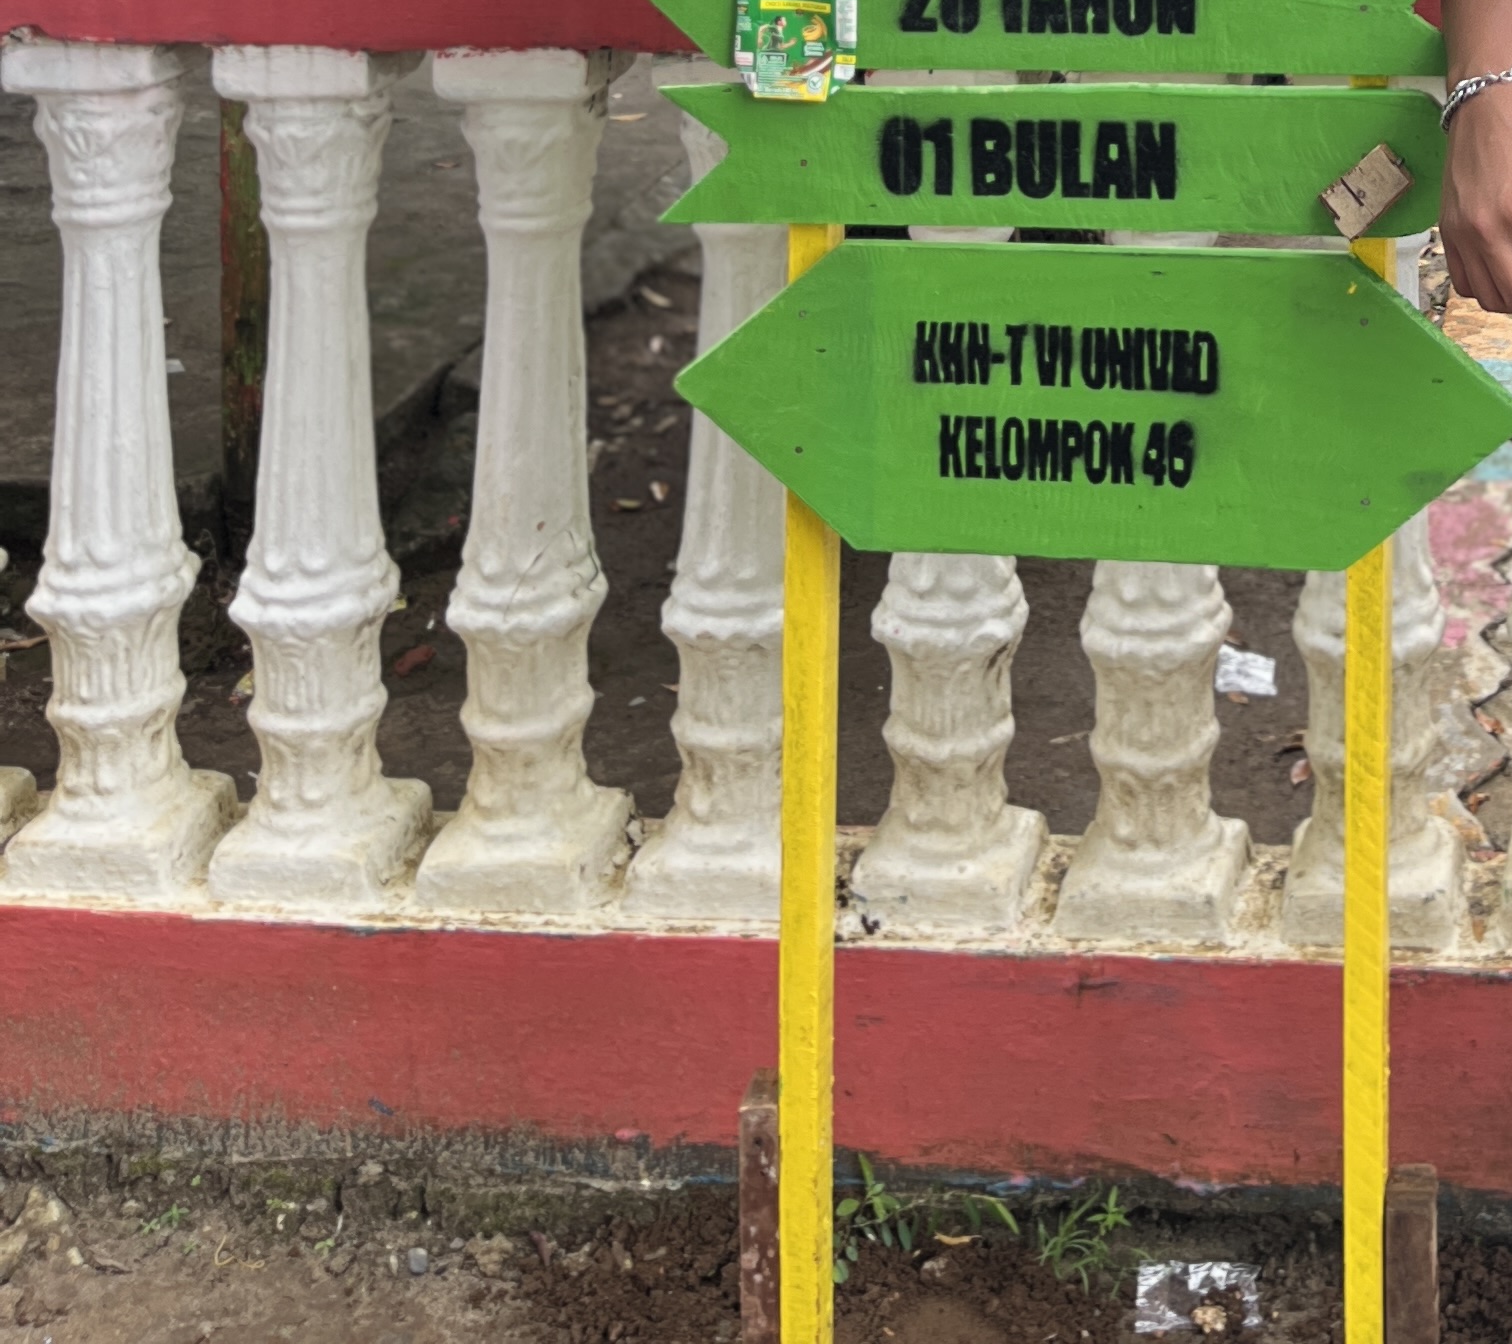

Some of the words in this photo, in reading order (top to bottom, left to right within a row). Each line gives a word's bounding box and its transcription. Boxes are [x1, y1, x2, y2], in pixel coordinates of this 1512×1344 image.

[878, 116, 954, 197] 01
[970, 118, 1177, 201] BULAN
[1081, 327, 1219, 395] UNIVED
[939, 414, 1136, 486] KELOMPOK
[1143, 420, 1195, 488] 46
